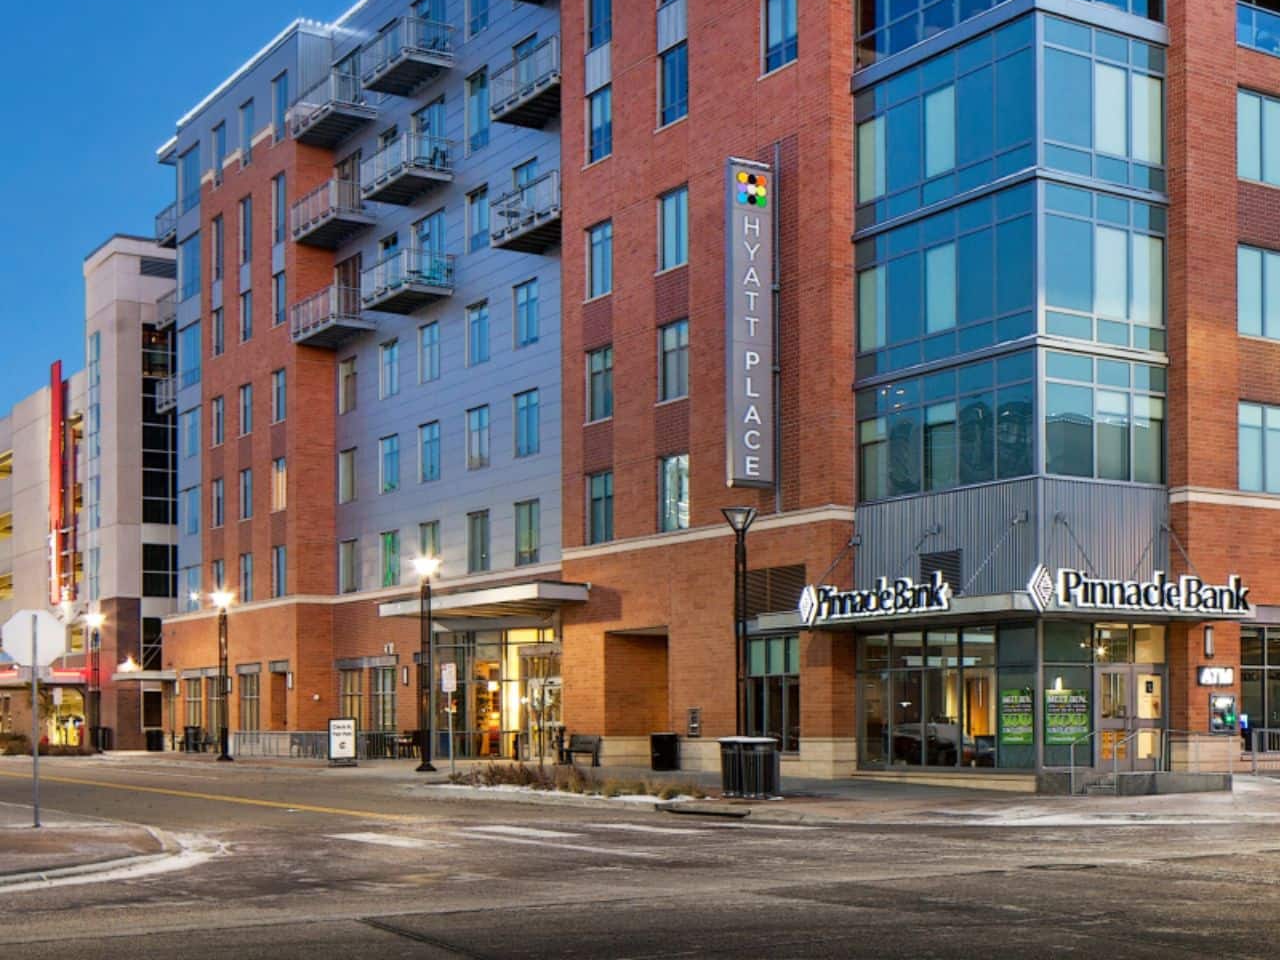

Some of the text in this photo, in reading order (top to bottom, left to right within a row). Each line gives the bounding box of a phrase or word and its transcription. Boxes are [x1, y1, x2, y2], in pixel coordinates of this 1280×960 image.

[744, 215, 761, 477] HYATT PLACE
[1199, 667, 1234, 685] ATM
